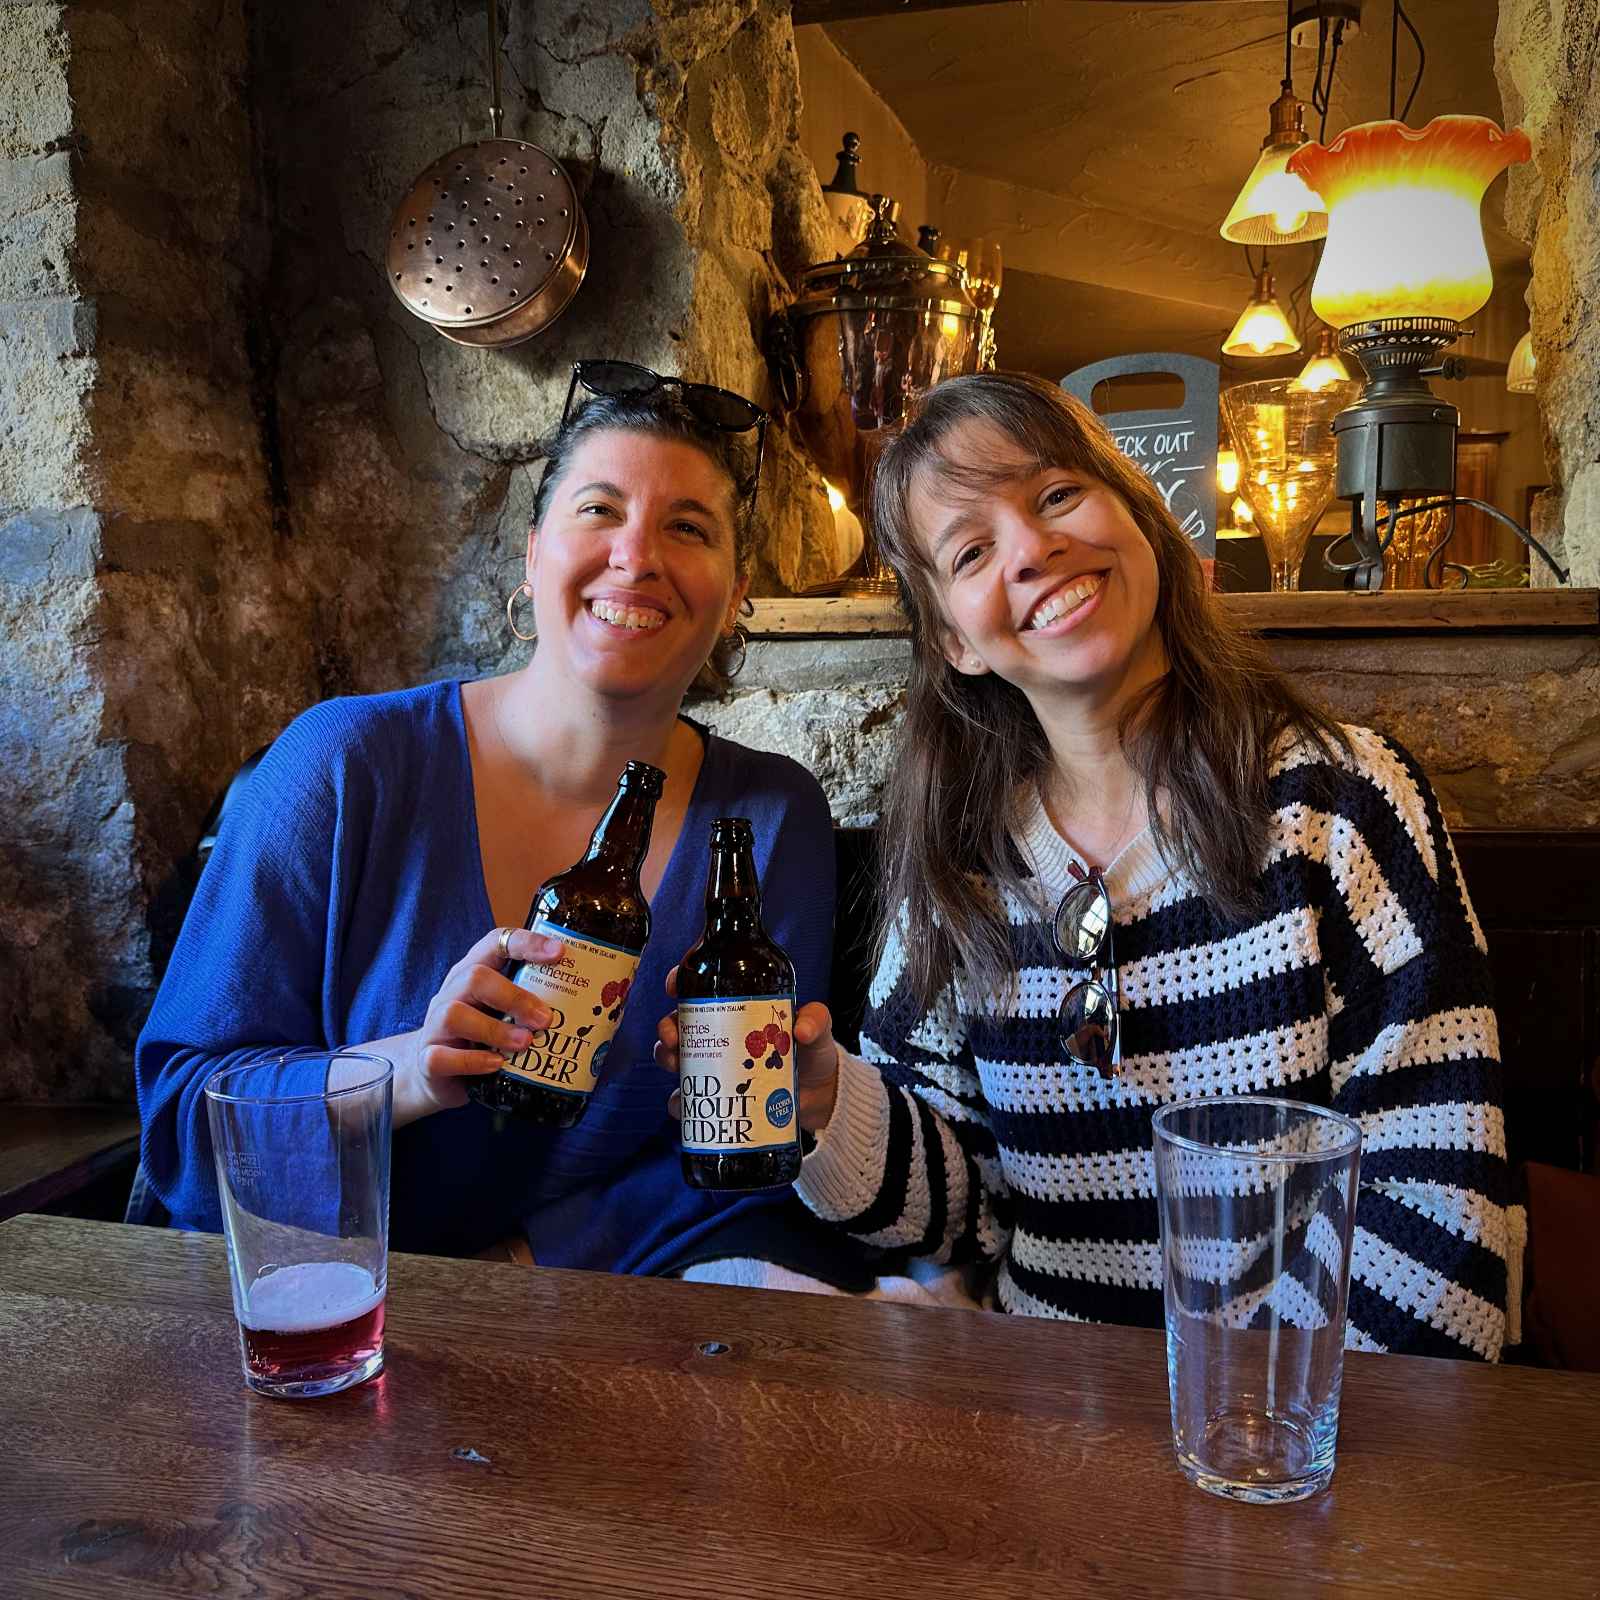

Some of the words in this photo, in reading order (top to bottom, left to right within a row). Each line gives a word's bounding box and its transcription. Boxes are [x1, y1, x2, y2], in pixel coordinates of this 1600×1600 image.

[1113, 435, 1148, 457] ECK
[1153, 431, 1195, 455] OUT
[531, 1029, 590, 1060] OUT
[687, 1034, 730, 1048] cherries
[682, 1075, 721, 1097] OLD
[683, 1096, 756, 1119] MOUT
[768, 1097, 792, 1113] ALCOHOL
[775, 1106, 790, 1118] FREE
[683, 1119, 756, 1144] CIDER
